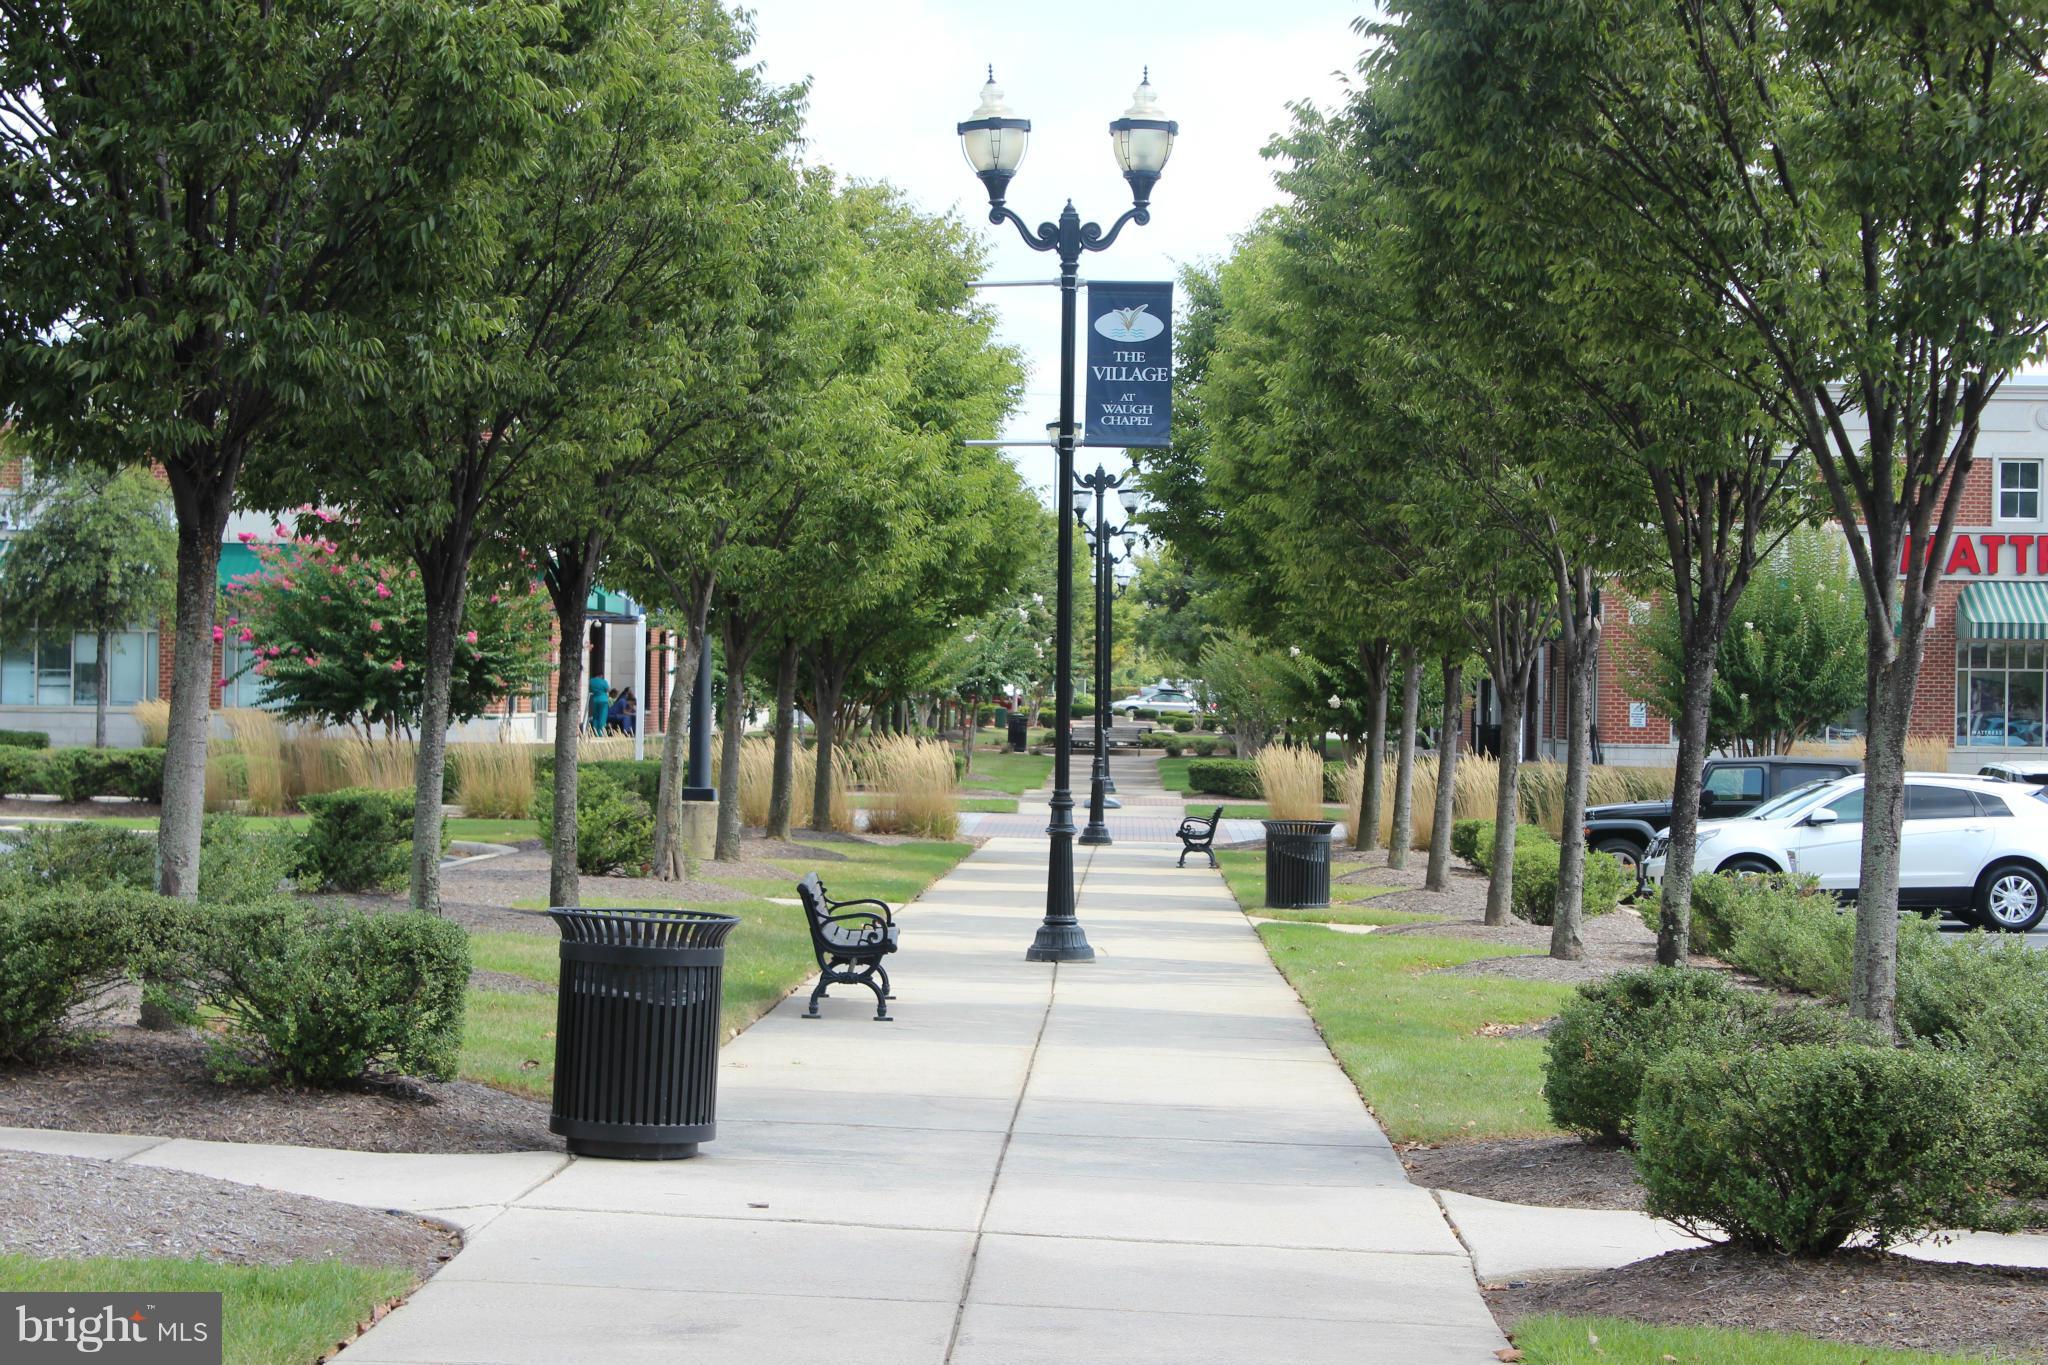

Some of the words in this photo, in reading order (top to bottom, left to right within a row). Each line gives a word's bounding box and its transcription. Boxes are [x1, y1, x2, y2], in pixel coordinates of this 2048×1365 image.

[1113, 351, 1146, 362] THE
[1092, 366, 1168, 382] VILLAGE
[1120, 393, 1136, 402] AT
[1102, 404, 1154, 415] WAUGH
[1101, 416, 1153, 426] CHAPEL
